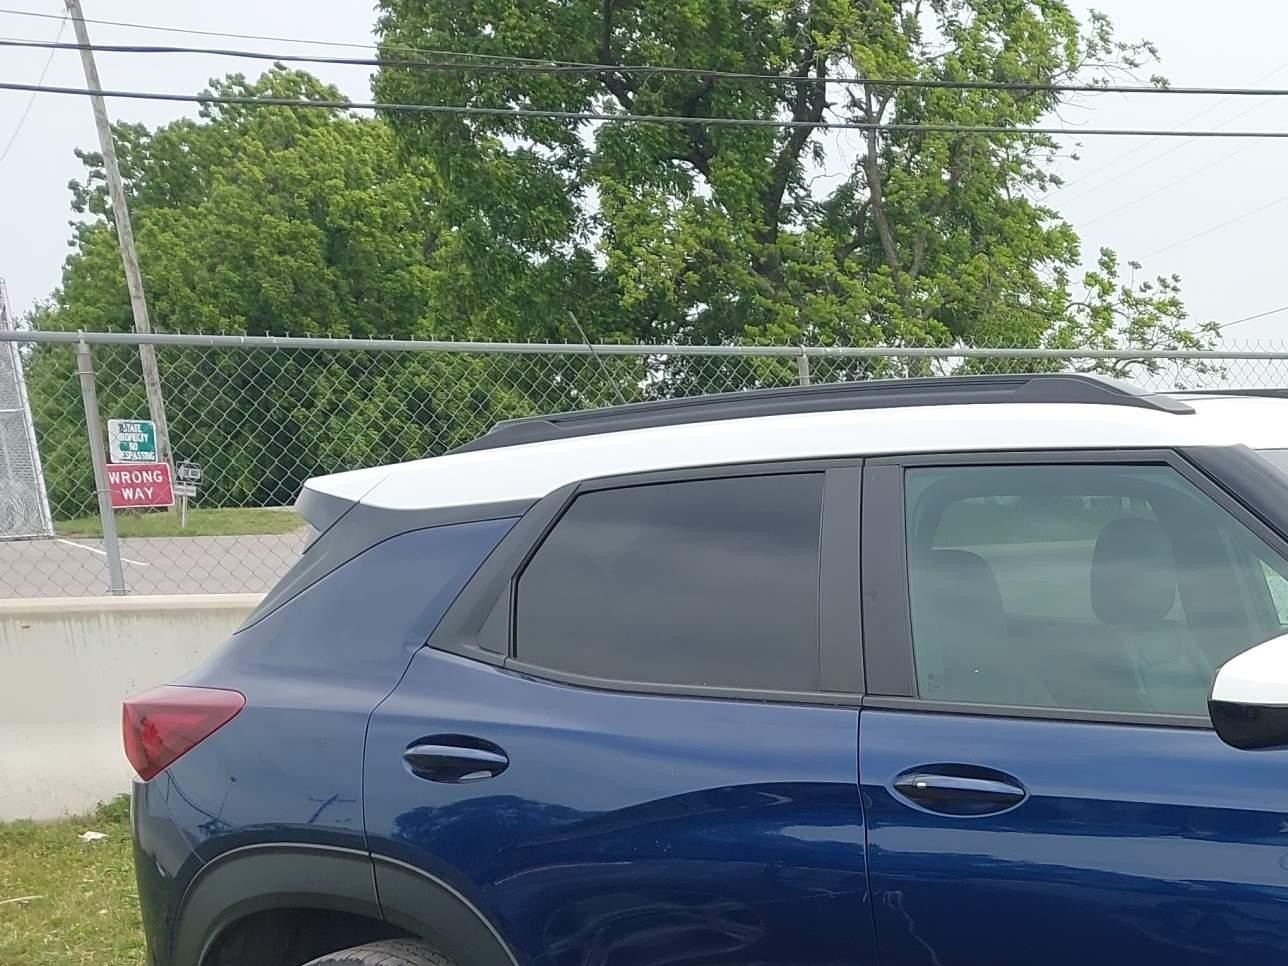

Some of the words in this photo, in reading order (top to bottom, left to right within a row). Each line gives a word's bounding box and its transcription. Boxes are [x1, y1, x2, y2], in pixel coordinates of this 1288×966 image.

[122, 423, 142, 433] STATE
[129, 442, 139, 451] NO
[108, 471, 163, 484] WRONG
[121, 487, 154, 500] WAY
